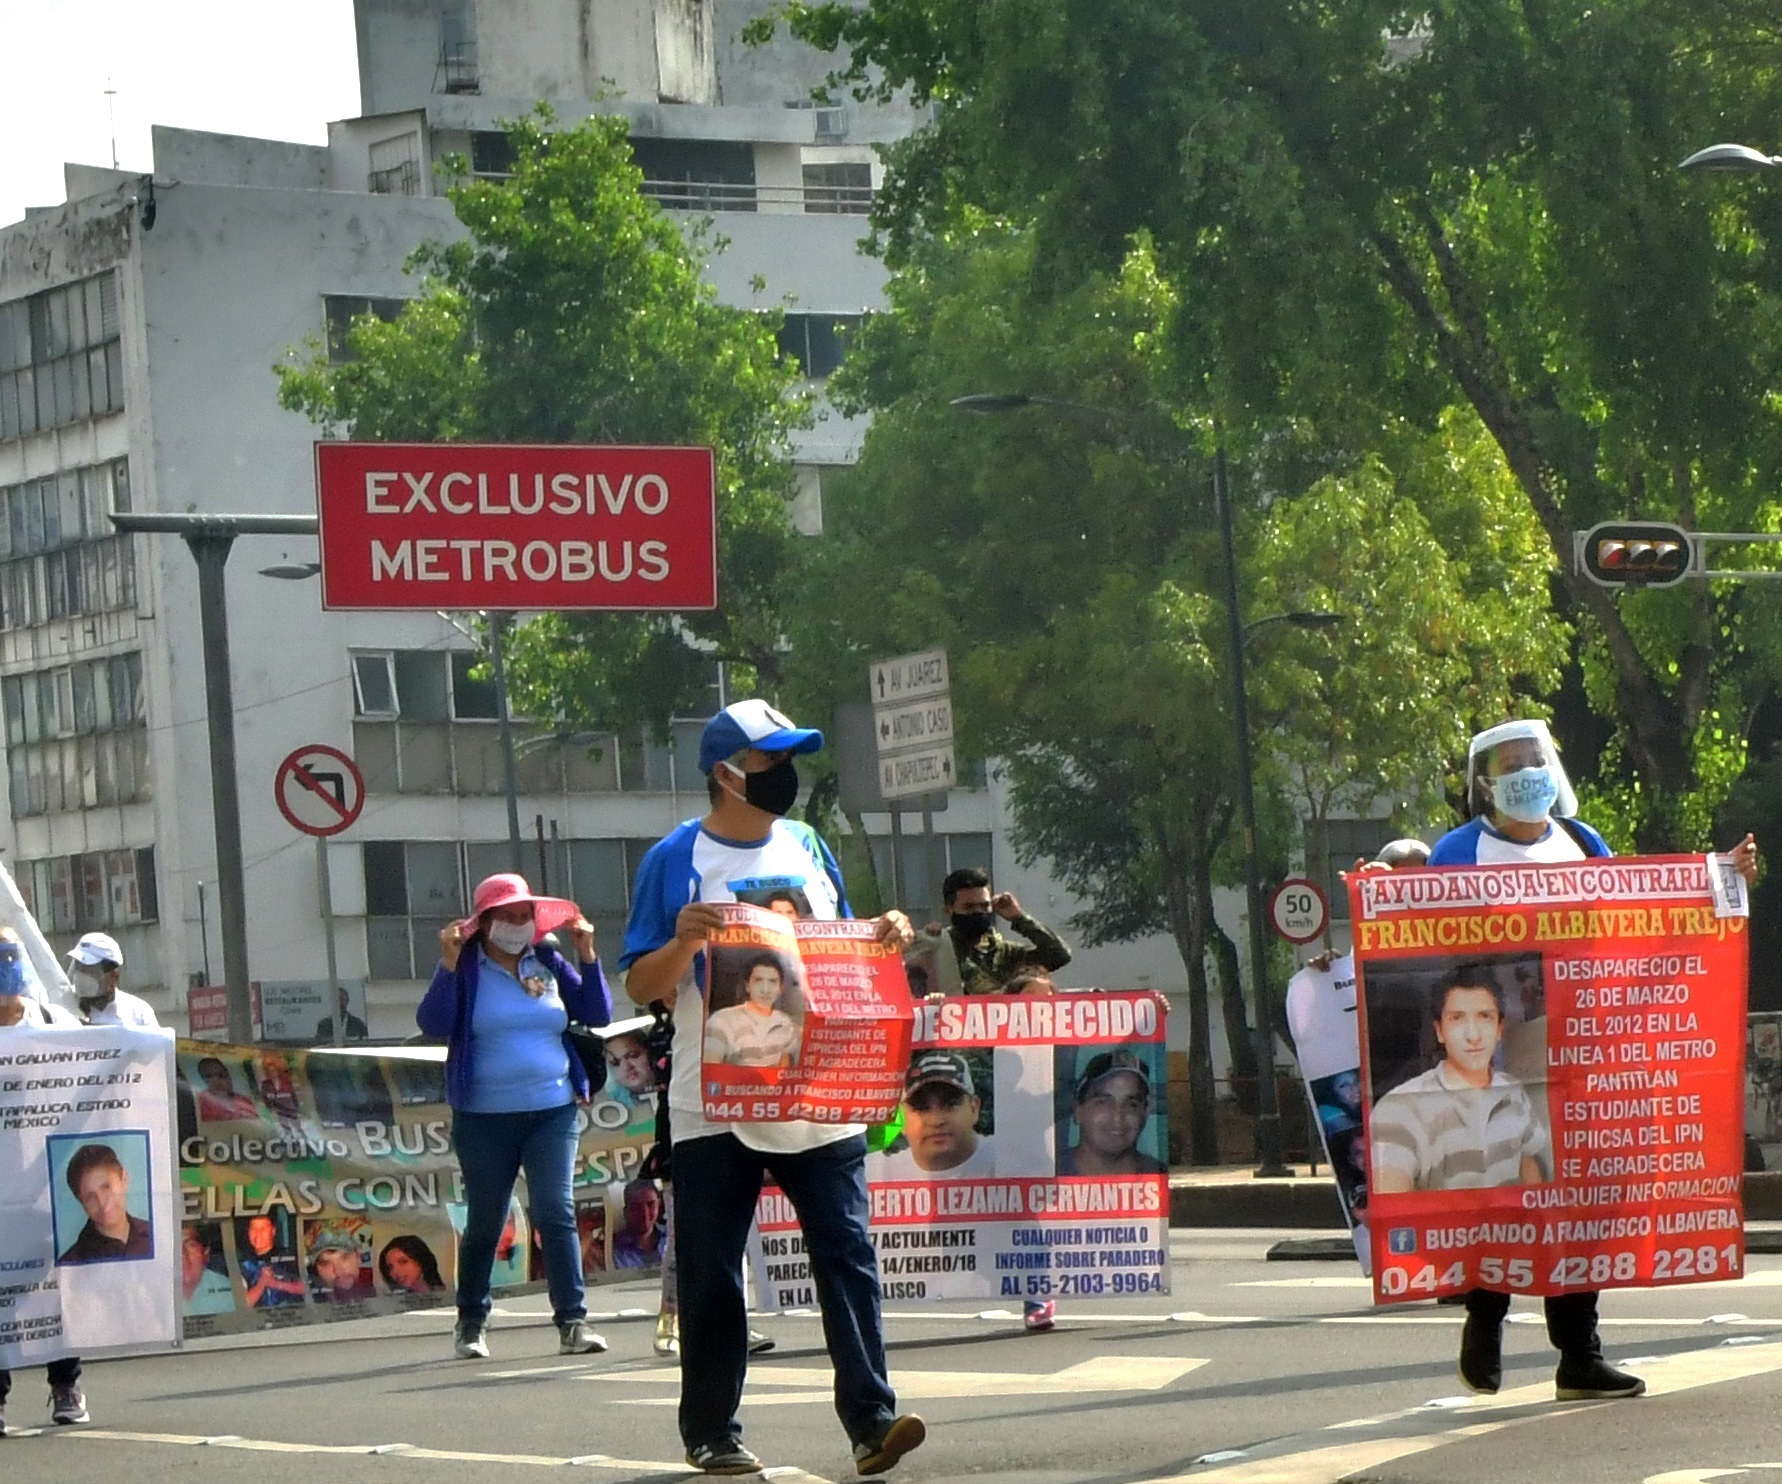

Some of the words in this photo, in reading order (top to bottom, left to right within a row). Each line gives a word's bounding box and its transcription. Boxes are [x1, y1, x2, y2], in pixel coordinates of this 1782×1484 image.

[364, 472, 670, 517] EXCLUSIVO
[369, 539, 670, 583] METROBUS
[1545, 866, 1709, 898] ENCONTRARL
[1286, 894, 1312, 914] 50
[1360, 914, 1528, 951] FRANCISCO
[1534, 908, 1664, 942] ALBAVERA
[1668, 905, 1744, 941] TREJO
[1554, 957, 1681, 981] DESAPARECIO
[1684, 956, 1707, 976] EL
[1575, 990, 1595, 1008] 26
[1600, 988, 1623, 1007] DE
[1627, 984, 1689, 1005] MARZO
[1566, 1015, 1602, 1037] DEL
[1605, 1015, 1643, 1035] 2012
[1646, 1013, 1671, 1033] EN
[1674, 1011, 1698, 1031] LA
[76, 1049, 122, 1061] PEREZ
[1548, 1045, 1604, 1067] LINEA
[1607, 1045, 1616, 1064] 1
[1621, 1043, 1652, 1063] DEL
[1656, 1039, 1717, 1060] METRO
[4, 1081, 23, 1092] DE
[25, 1077, 74, 1090] ENERO
[77, 1075, 104, 1087] DEL
[107, 1073, 142, 1085] 2012
[1587, 1069, 1679, 1092] PANTITLAN
[75, 1098, 131, 1113] ESTADO
[752, 1102, 780, 1119] 55
[787, 1101, 843, 1121] 4288
[1564, 1099, 1673, 1122] ESTUDIANTE
[1677, 1097, 1701, 1116] DE
[4, 1117, 60, 1130] MEXICO
[1639, 1127, 1671, 1146] DEL
[1675, 1123, 1704, 1143] IPN
[181, 1134, 348, 1164] Colectivo
[1562, 1158, 1581, 1178] SE
[1587, 1153, 1705, 1178] AGRADECERA
[334, 1172, 438, 1212] CON
[937, 1183, 1023, 1216] LEZAMA
[1028, 1181, 1160, 1214] CERVANTES
[1522, 1185, 1621, 1210] CUALQUIER
[1625, 1176, 1740, 1204] INFORMACION
[882, 1229, 976, 1250] ACTULMENTE
[1012, 1227, 1081, 1248] CUALQUIER
[1085, 1226, 1138, 1245] NOTICIA
[1140, 1226, 1148, 1243] O
[1426, 1223, 1536, 1249] BUSCANDO
[1542, 1222, 1556, 1243] A
[1557, 1215, 1652, 1242] FRANCISCO
[1656, 1208, 1740, 1235] ALBAVERA
[761, 1233, 788, 1257] ÑOS
[881, 1254, 977, 1275] 14/ENERO/18
[995, 1252, 1052, 1270] INFORME
[1055, 1251, 1096, 1268] SOBRE
[1099, 1248, 1165, 1267] PARADERO
[1382, 1261, 1465, 1295] 044
[1479, 1258, 1533, 1287] 55
[1549, 1252, 1636, 1285] 4288
[1653, 1244, 1738, 1280] 2281
[878, 1281, 926, 1299] LISCO
[1001, 1275, 1023, 1296] AL
[1026, 1272, 1162, 1296] 55-2103-9964
[779, 1289, 795, 1307] EN
[797, 1287, 812, 1305] LA
